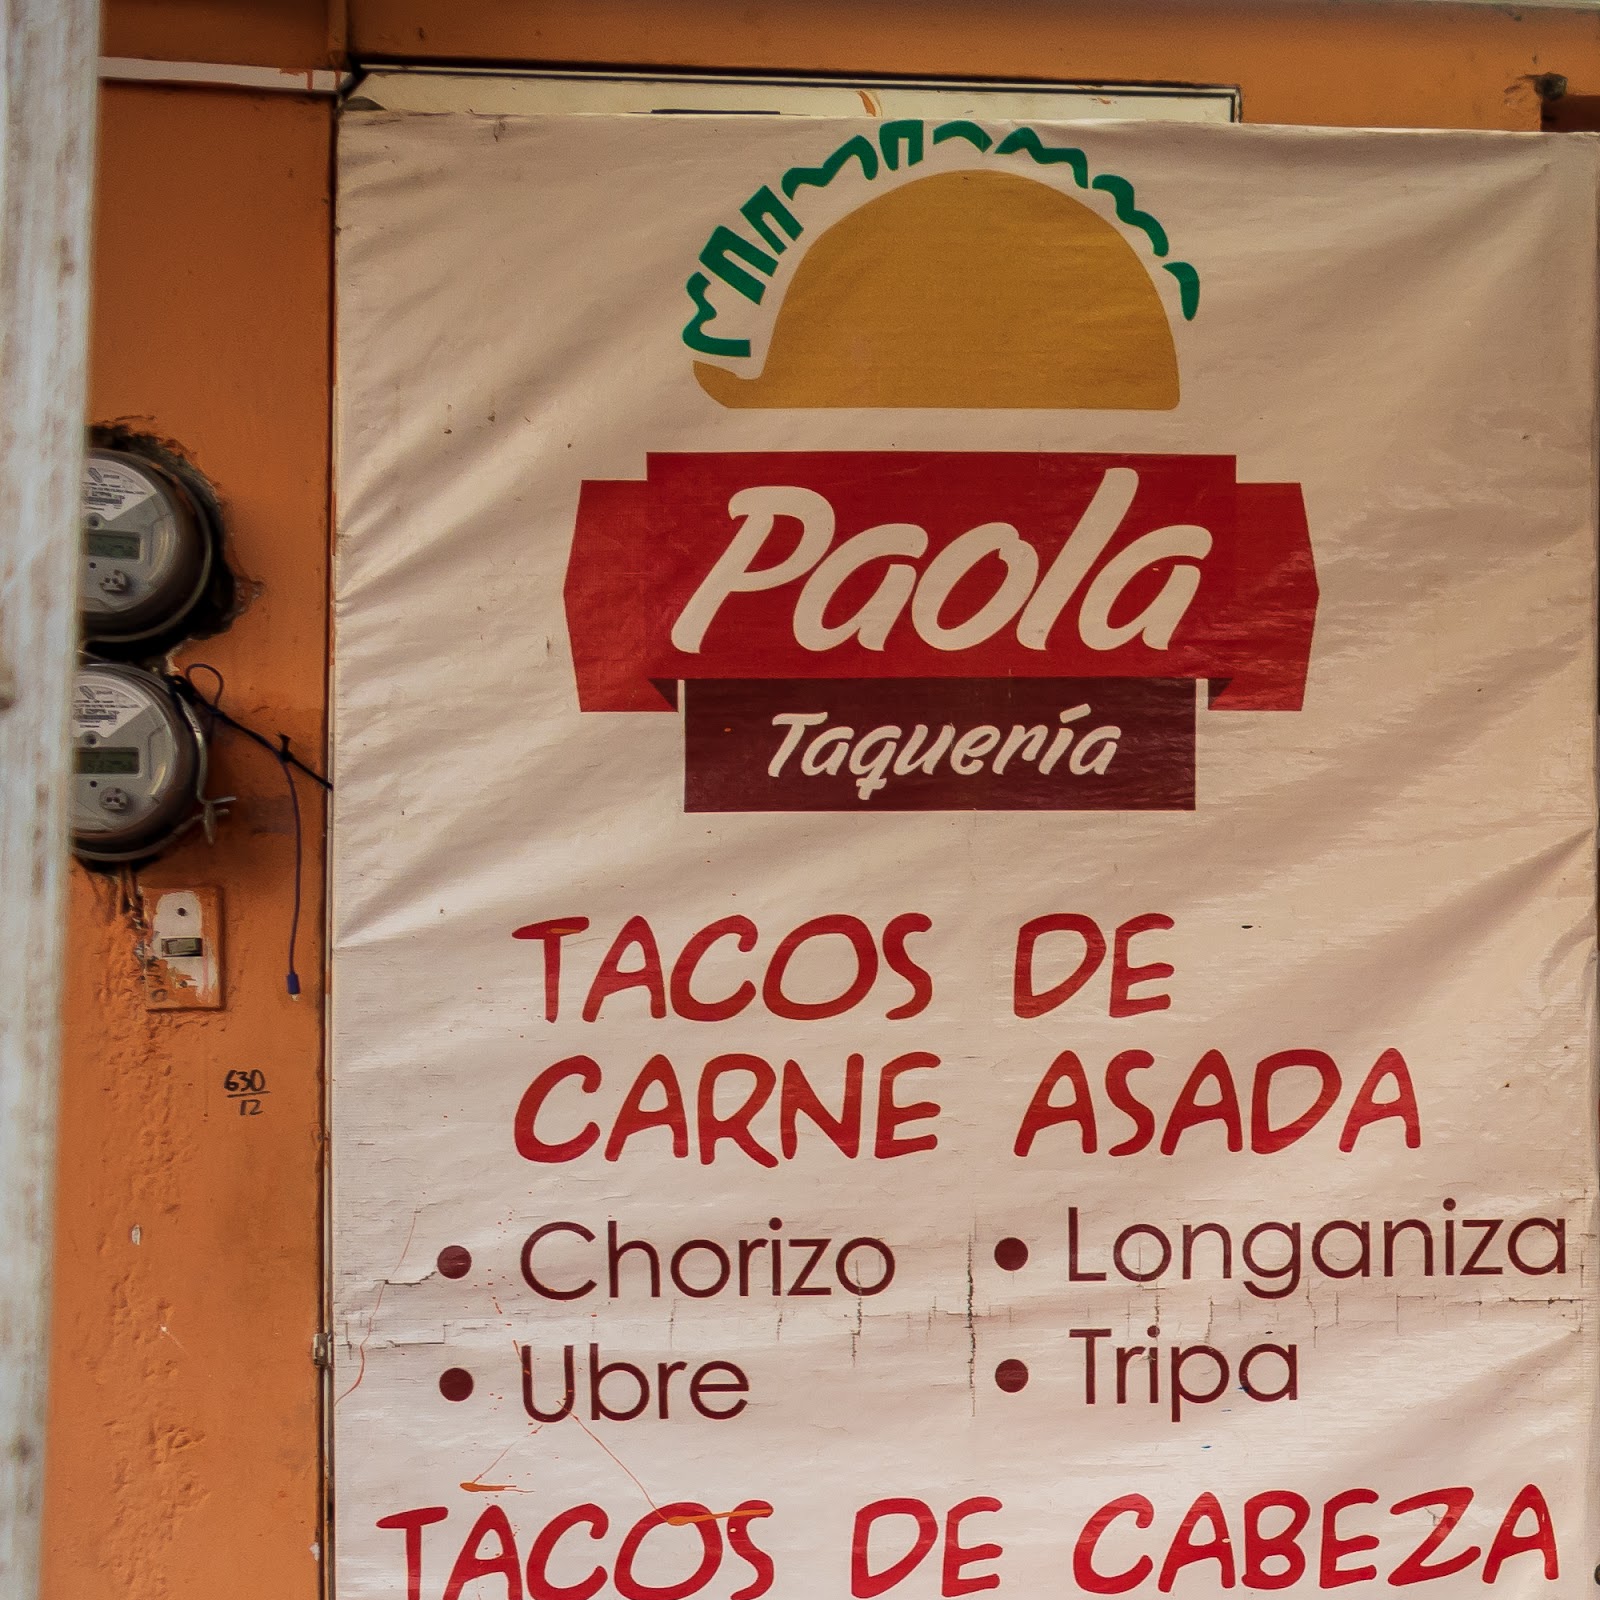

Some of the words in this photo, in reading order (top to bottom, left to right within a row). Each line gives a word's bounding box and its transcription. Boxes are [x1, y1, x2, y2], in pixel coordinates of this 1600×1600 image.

[672, 467, 1212, 653] Paola
[769, 703, 1120, 801] Taquería
[513, 913, 933, 1023] TACOS
[1013, 912, 1176, 1019] DE
[224, 1069, 266, 1092] 630
[239, 1099, 264, 1116] 12
[513, 1052, 942, 1168] CARNE
[1013, 1047, 1422, 1156] ASADA
[520, 1217, 897, 1299] Chorizo
[1066, 1197, 1568, 1299] Longaniza
[520, 1342, 750, 1423] Ubre
[1068, 1324, 1300, 1422] Tripa
[851, 1495, 1002, 1599] DE
[1071, 1483, 1560, 1596] CABEZA
